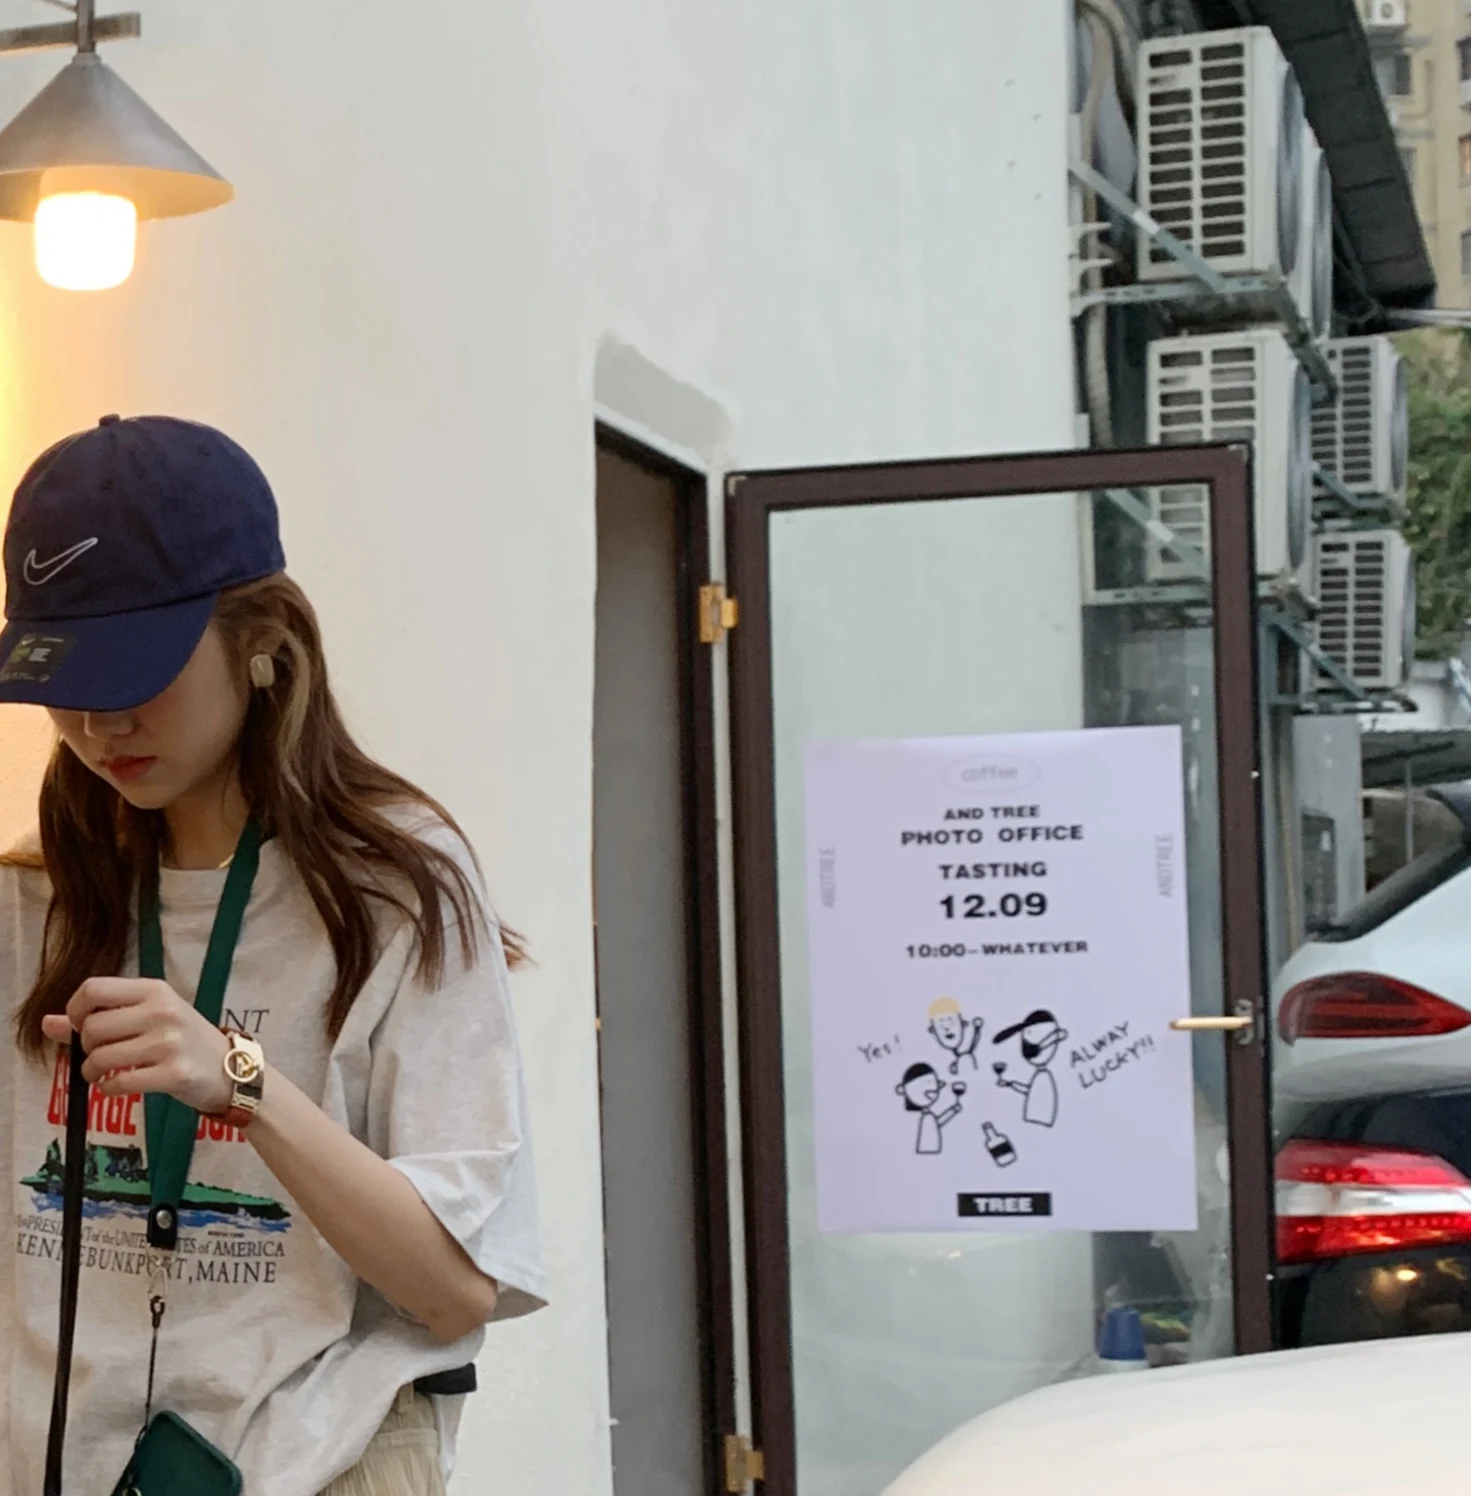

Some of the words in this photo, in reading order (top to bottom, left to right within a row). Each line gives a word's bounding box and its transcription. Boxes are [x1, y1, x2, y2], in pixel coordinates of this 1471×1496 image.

[943, 807, 984, 821] AND
[990, 804, 1040, 819] TREE
[901, 829, 983, 846] PHOTO
[998, 824, 1084, 842] OFFICE
[939, 861, 1048, 880] TASTING
[939, 892, 1048, 919] 12.09
[1070, 1020, 1130, 1068] ALWAY
[972, 1197, 1033, 1213] TREE
[115, 1228, 147, 1248] UNITE
[198, 1240, 211, 1254] of
[213, 1240, 285, 1257] AMERICA
[196, 1260, 277, 1283] MAINE
